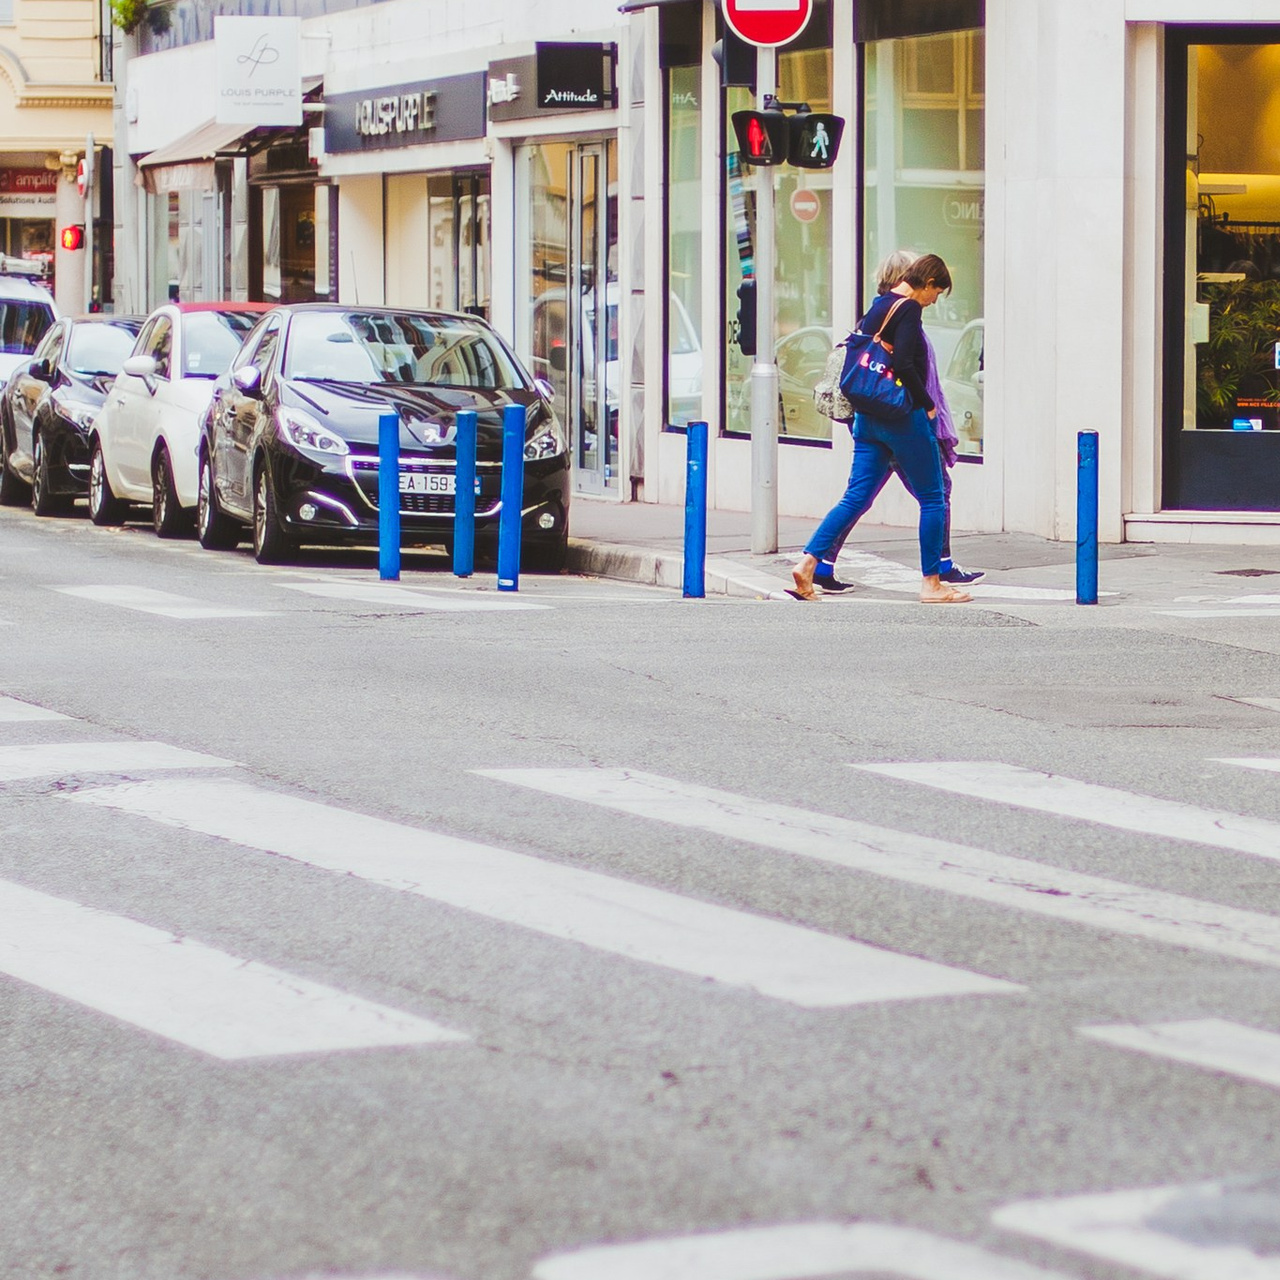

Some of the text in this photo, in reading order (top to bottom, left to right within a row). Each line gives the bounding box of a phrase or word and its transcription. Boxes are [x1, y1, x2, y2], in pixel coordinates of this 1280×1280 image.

[221, 88, 296, 97] LOUIS PURPLE
[544, 88, 598, 103] Attitude
